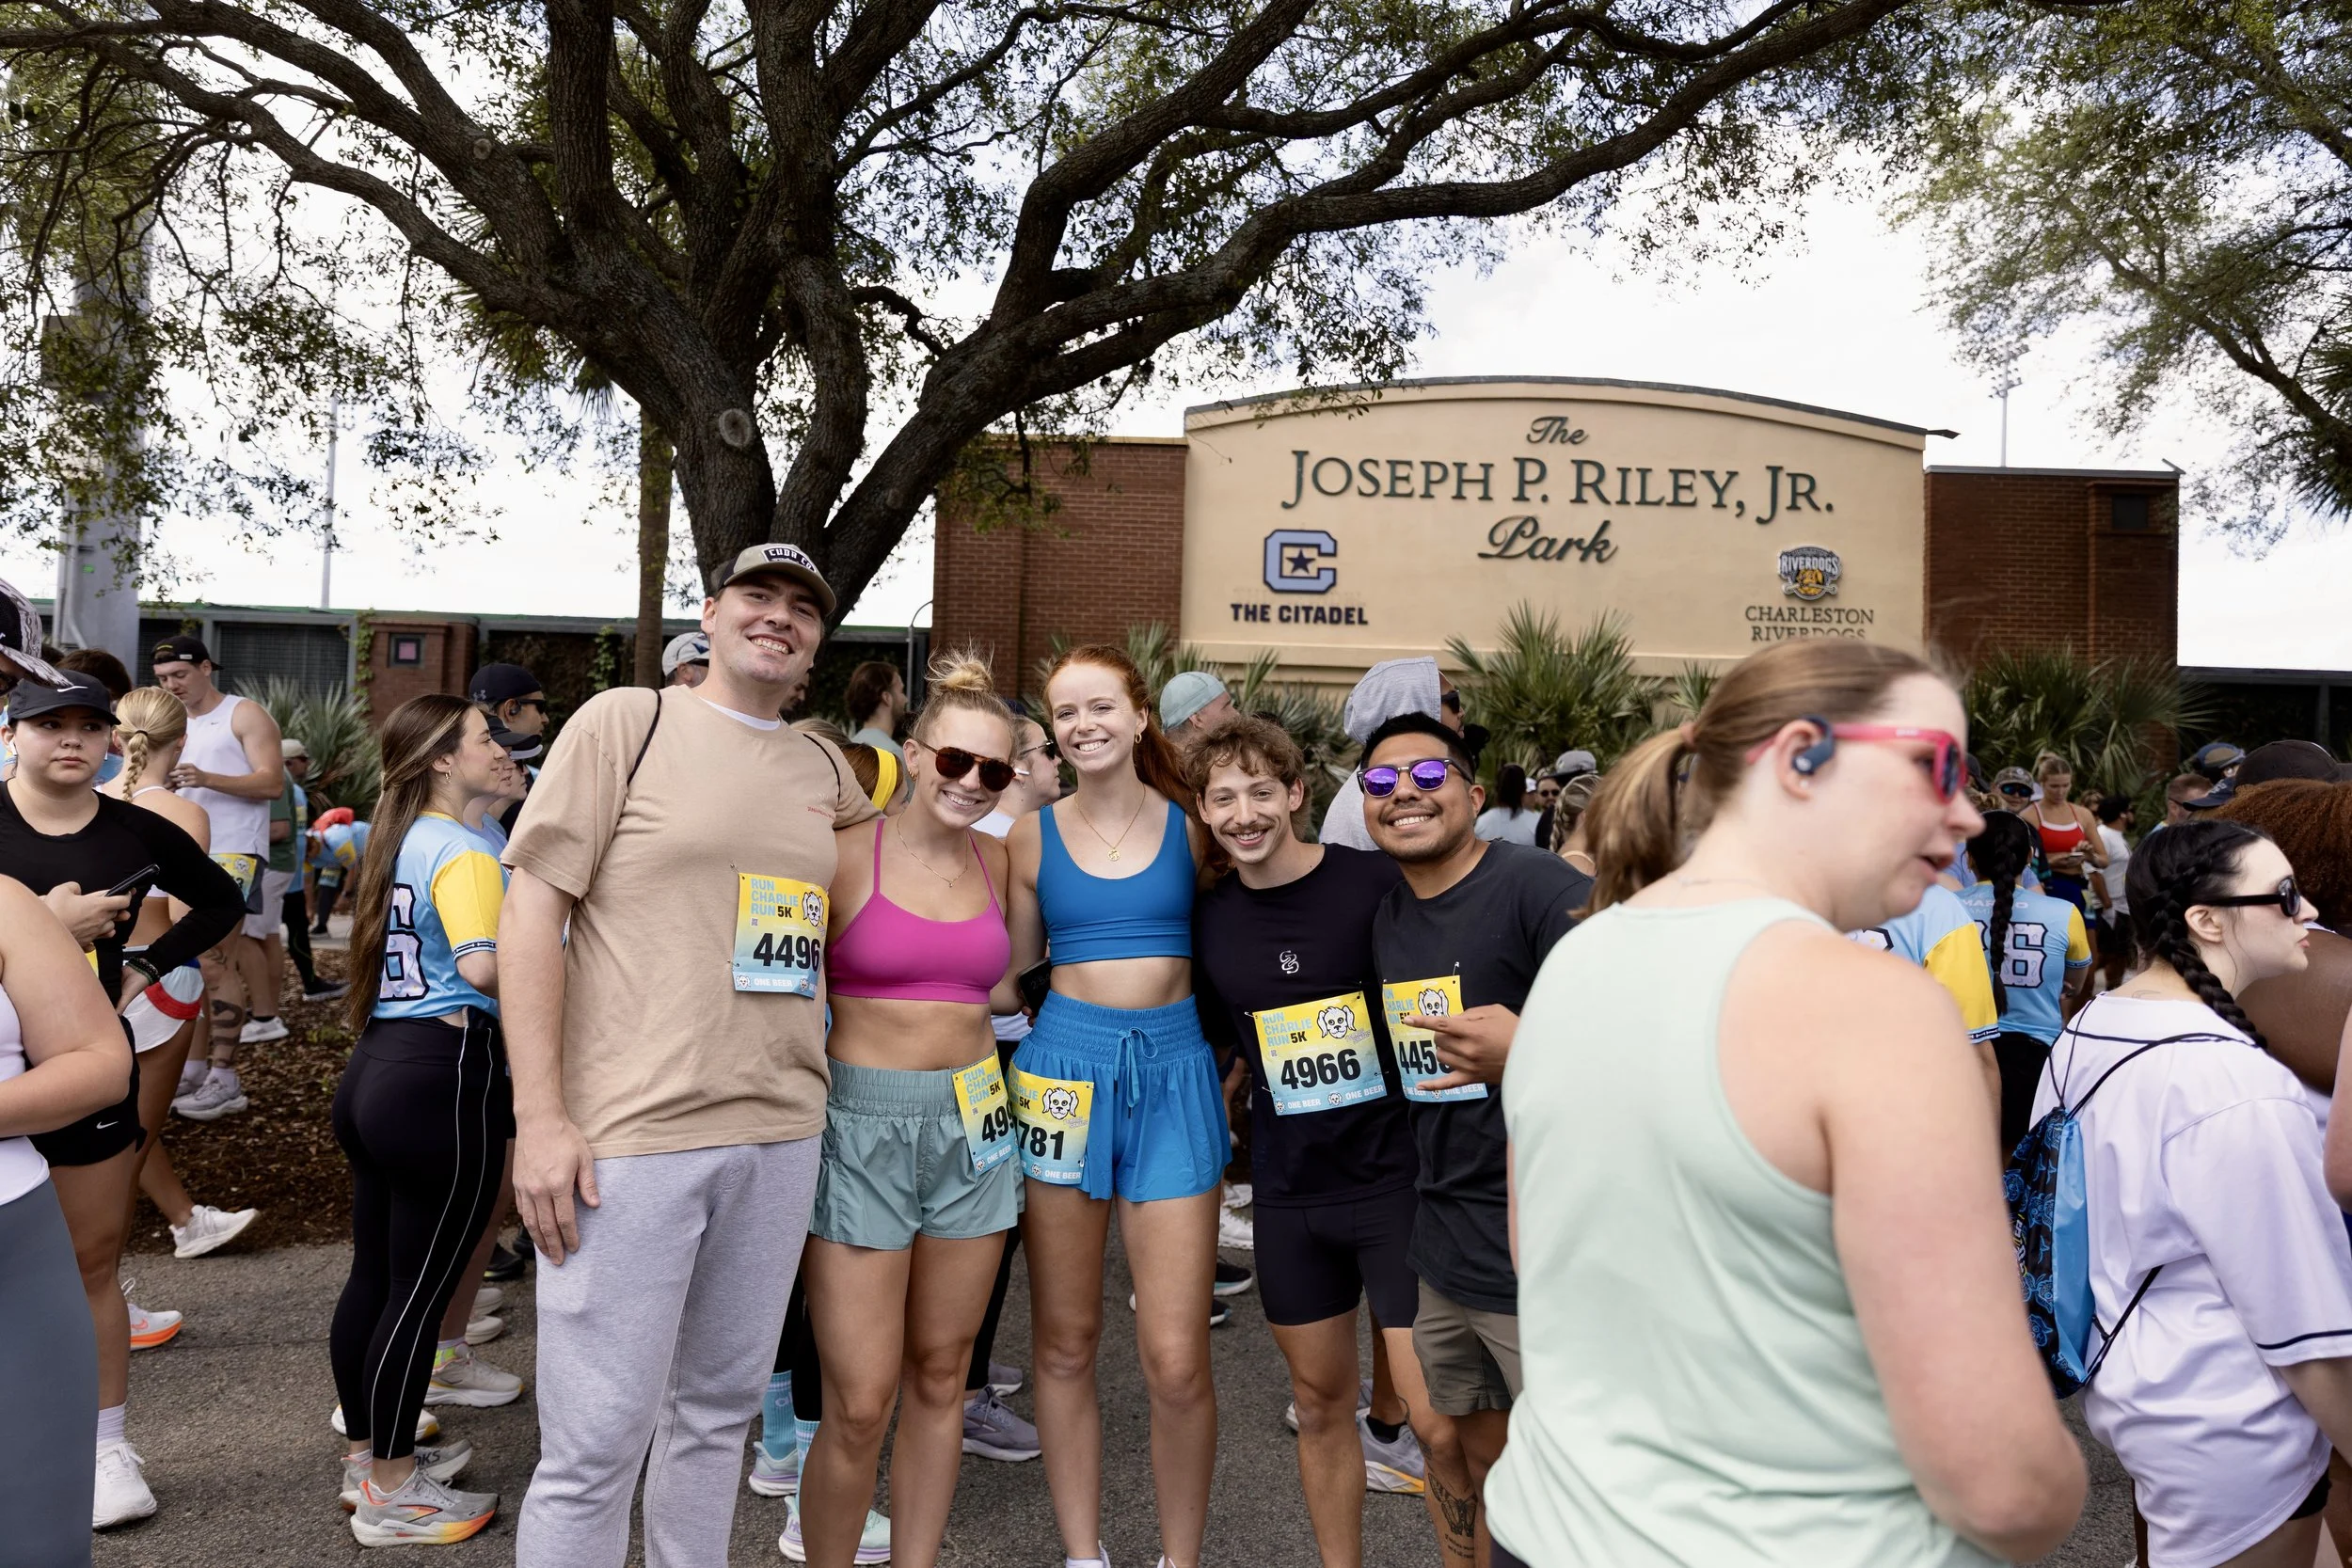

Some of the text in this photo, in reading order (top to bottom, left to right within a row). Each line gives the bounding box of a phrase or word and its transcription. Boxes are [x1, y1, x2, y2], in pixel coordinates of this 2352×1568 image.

[1525, 416, 1588, 445] The
[1280, 450, 1834, 525] JOSEPH P. RILEY, JR.
[1477, 514, 1618, 563] Park
[1781, 554, 1838, 575] RIVERDOGS
[1231, 603, 1369, 626] THE CITADEL
[1744, 606, 1874, 625] CHARLESTON
[750, 878, 774, 891] RUN
[750, 891, 799, 907] CHARLIE
[750, 905, 792, 918] RUN 5K
[753, 933, 820, 972] 4496
[1262, 1011, 1284, 1024] RUN
[1263, 1018, 1312, 1036] CHARLIE
[1267, 1031, 1307, 1047] RUN 5K
[1400, 1040, 1451, 1075] 445
[963, 1066, 985, 1083] RUN
[1280, 1049, 1361, 1090] 4966
[969, 1087, 991, 1105] RUN
[990, 1081, 1001, 1095] 5K
[1345, 1090, 1362, 1101] ONE
[1364, 1085, 1384, 1096] BEER
[1461, 1083, 1484, 1094] BEER
[1019, 1097, 1031, 1109] 5K
[1011, 1116, 1064, 1160] 781
